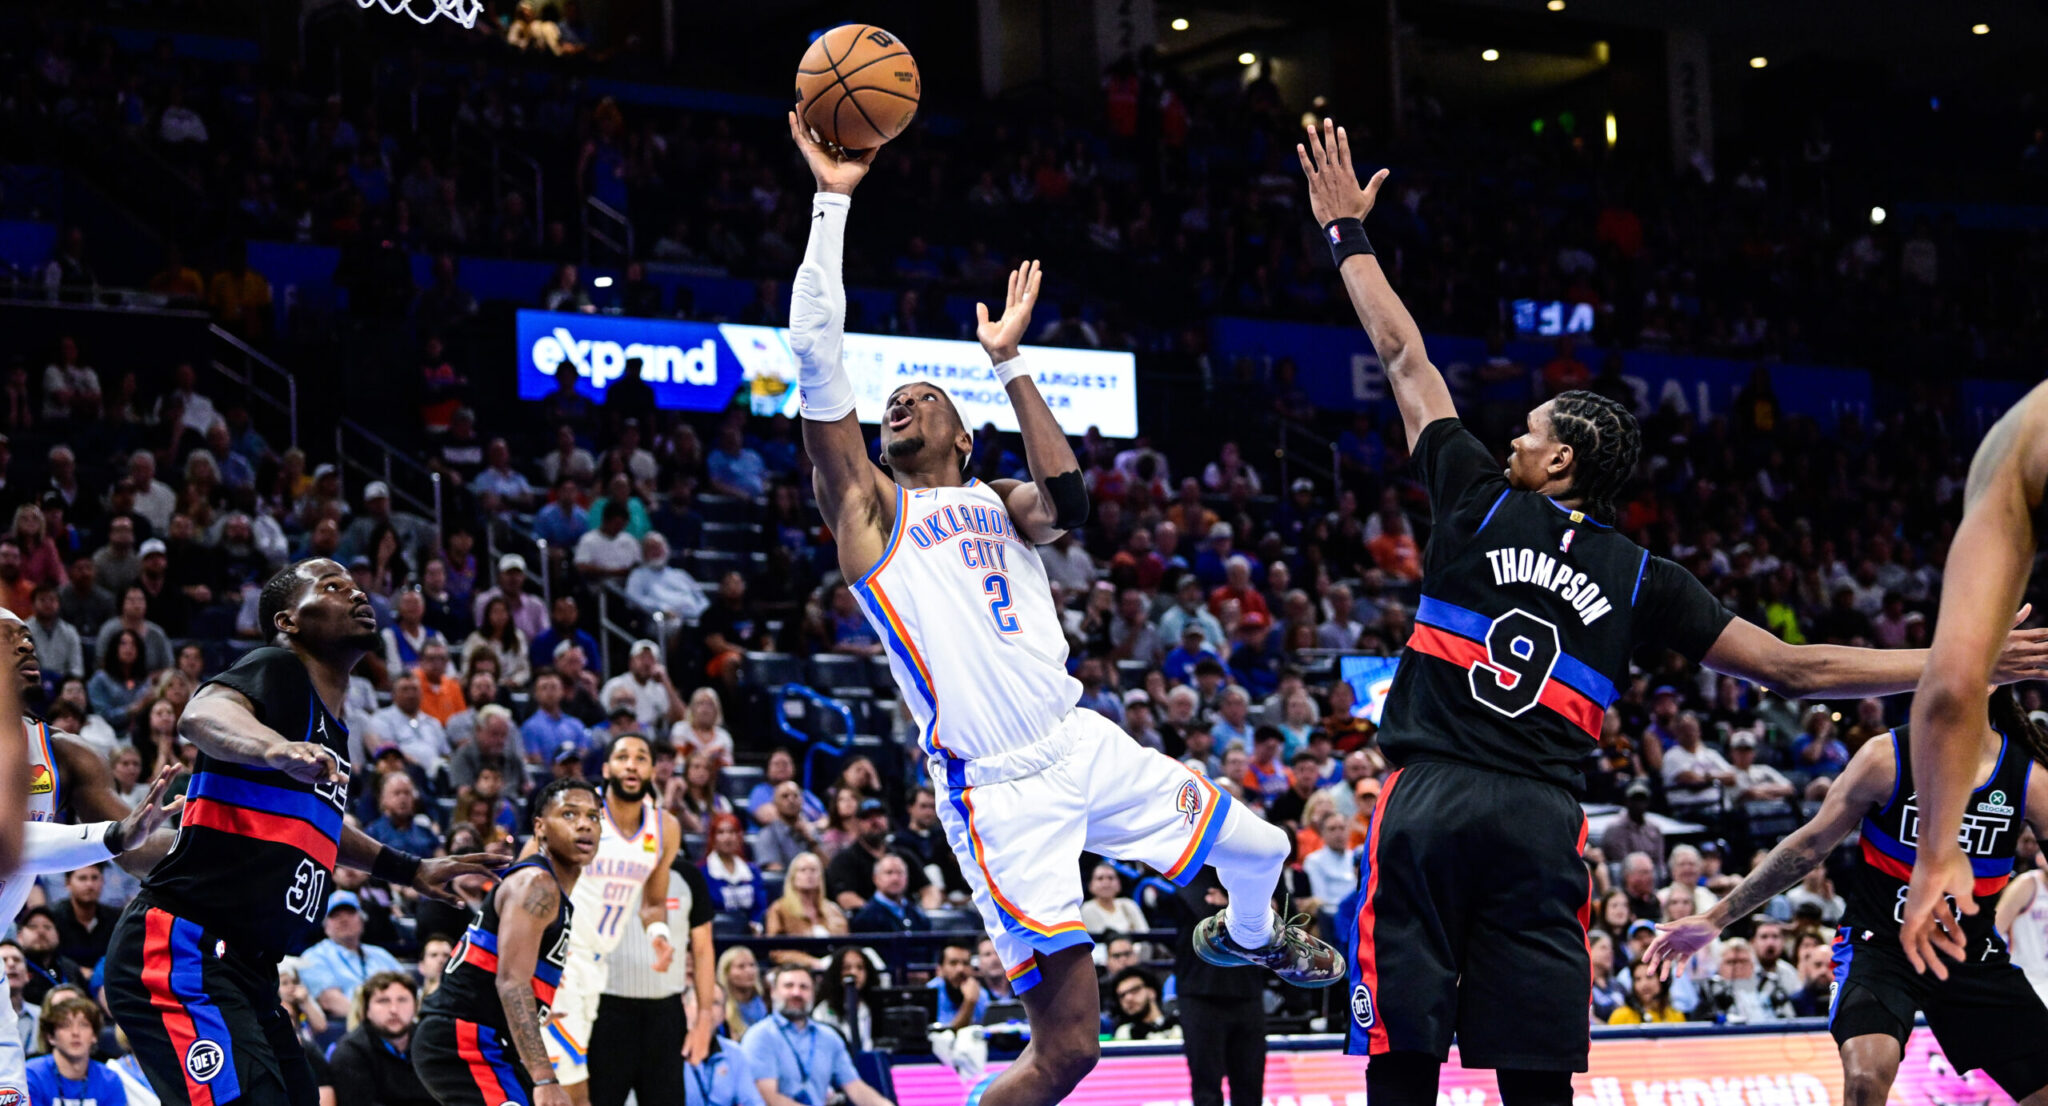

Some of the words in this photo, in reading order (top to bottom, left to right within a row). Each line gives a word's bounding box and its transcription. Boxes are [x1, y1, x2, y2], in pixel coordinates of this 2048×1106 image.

[1036, 370, 1120, 390] ARGEST
[907, 504, 1022, 550] OKLAHOM
[959, 537, 1009, 573] CITY
[982, 571, 1024, 636] 2
[1486, 547, 1613, 626] THOMPSON
[1467, 607, 1562, 718] 9
[286, 857, 326, 923] 31
[603, 881, 635, 900] CITY
[597, 904, 625, 936] 11
[192, 1050, 216, 1071] DET
